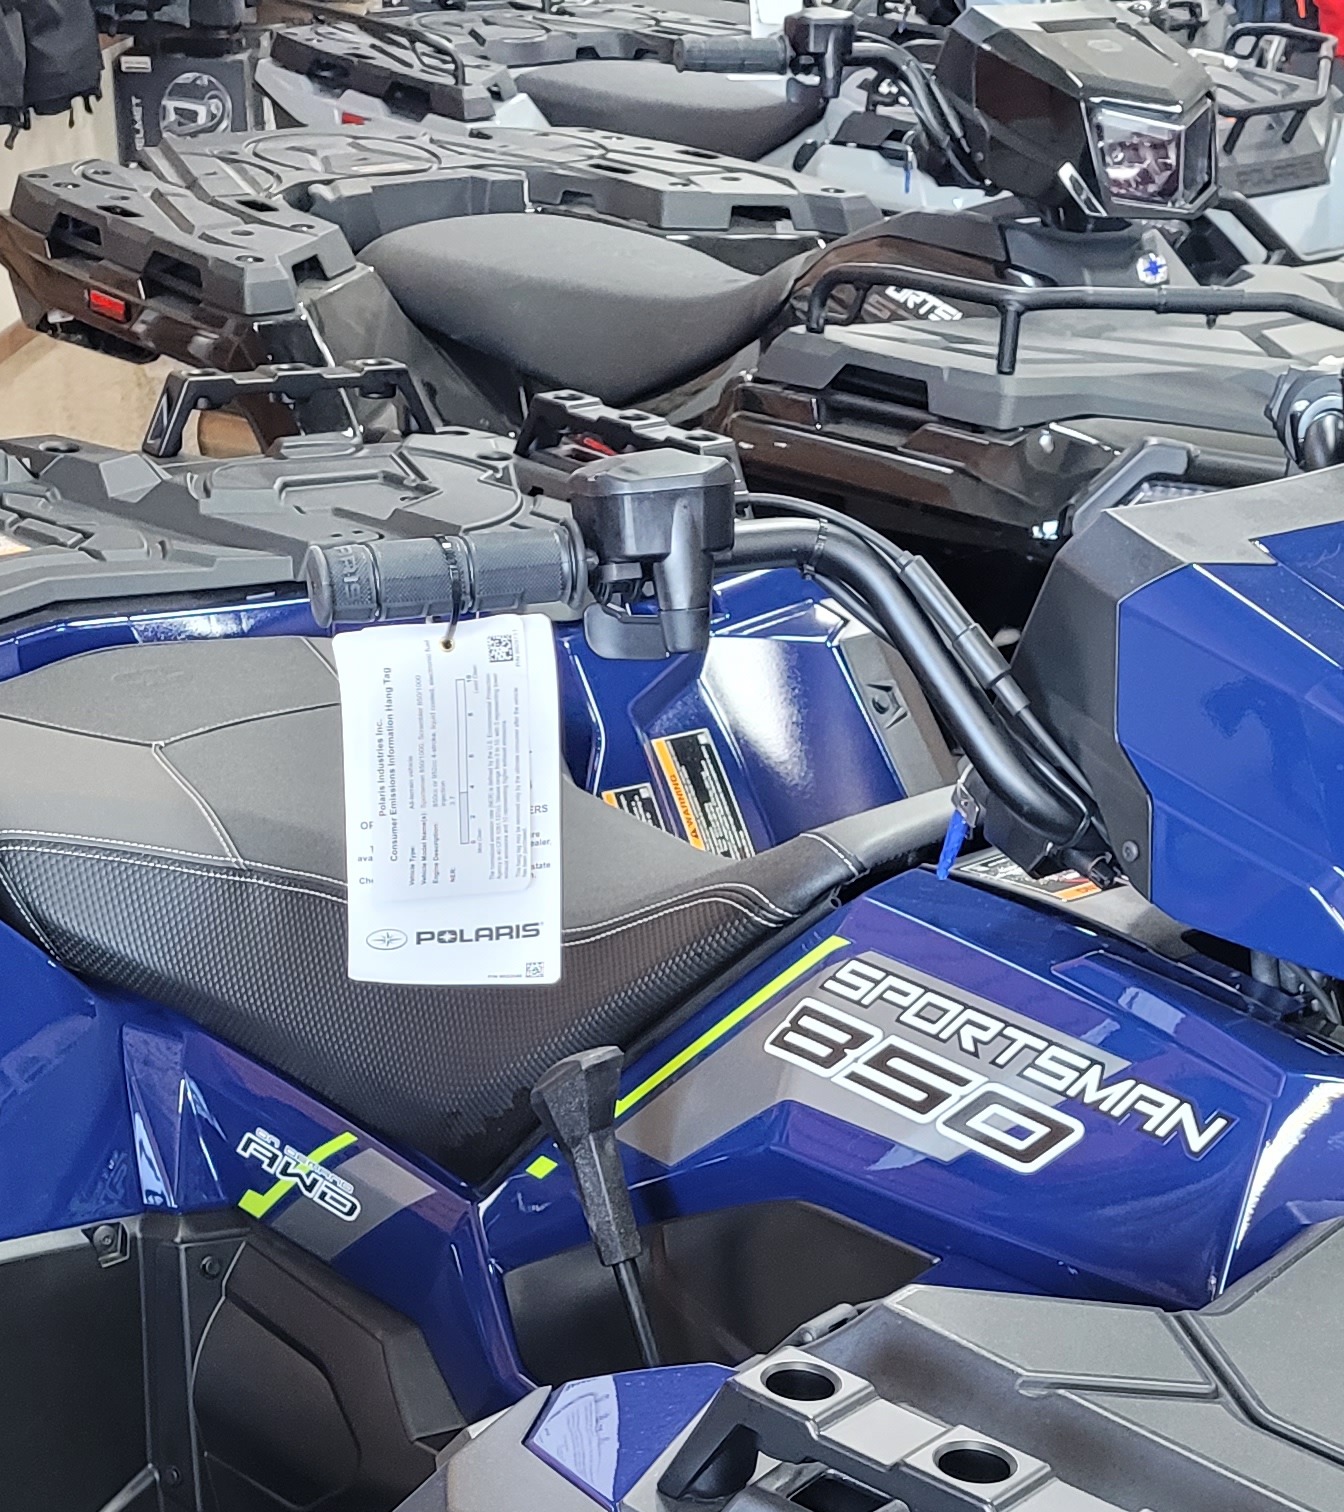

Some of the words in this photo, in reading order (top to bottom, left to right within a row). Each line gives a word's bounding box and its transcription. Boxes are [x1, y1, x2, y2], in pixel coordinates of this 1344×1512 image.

[383, 668, 391, 684] Tag
[385, 687, 393, 711] Hang
[376, 738, 385, 782] Industries
[387, 714, 395, 766] Information
[378, 786, 386, 816] Polaris
[389, 769, 397, 815] Emissions
[669, 774, 694, 826] WARNING
[390, 818, 398, 861] Consumer
[415, 923, 541, 946] POLARIS
[821, 958, 1236, 1157] SPORTSMAN
[764, 997, 1085, 1175] 850
[236, 1131, 361, 1221] AWD
